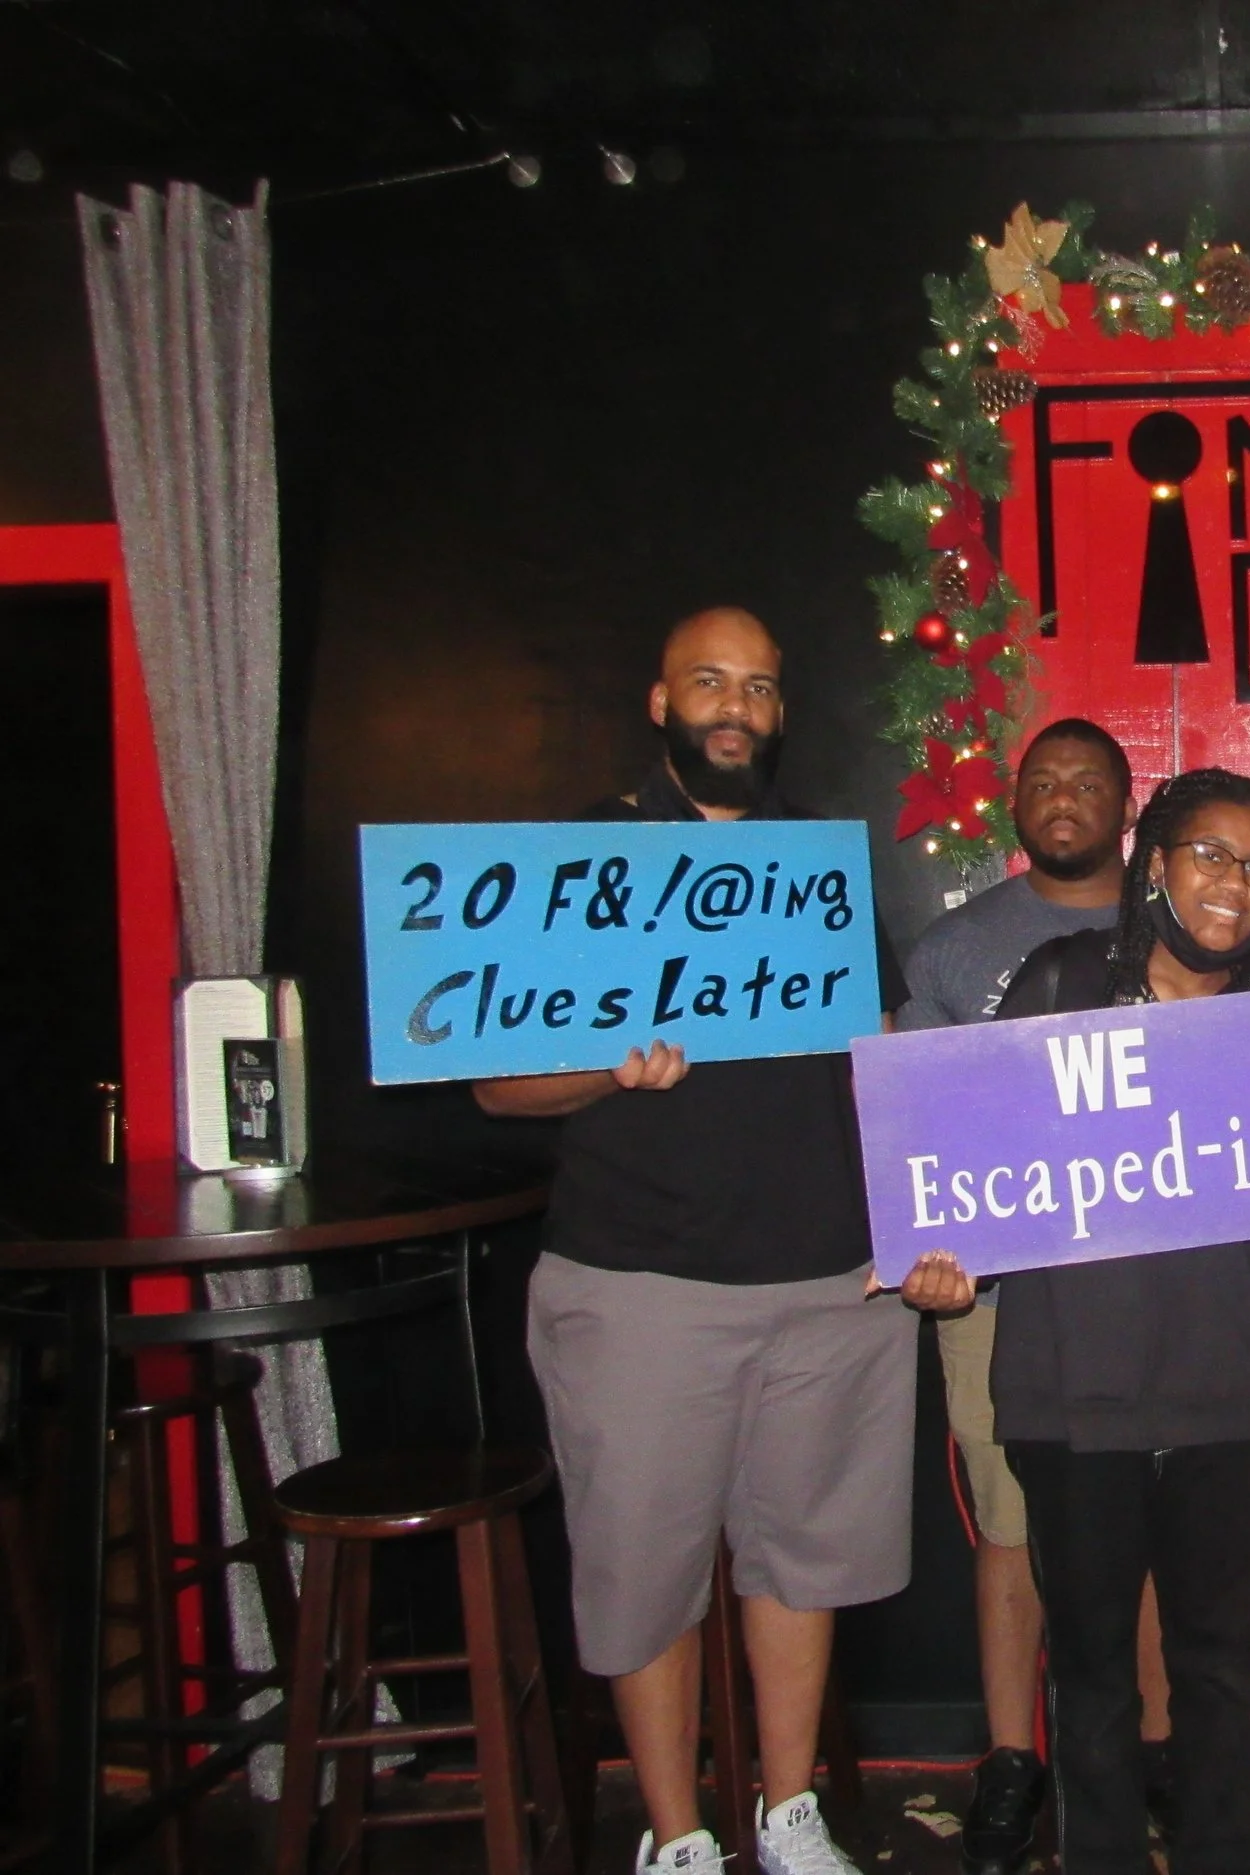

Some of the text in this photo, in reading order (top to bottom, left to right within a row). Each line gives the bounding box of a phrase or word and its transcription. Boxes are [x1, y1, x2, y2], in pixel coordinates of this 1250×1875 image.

[401, 861, 517, 932] 20
[407, 956, 851, 1046] Clues Later
[1046, 1028, 1152, 1115] WE
